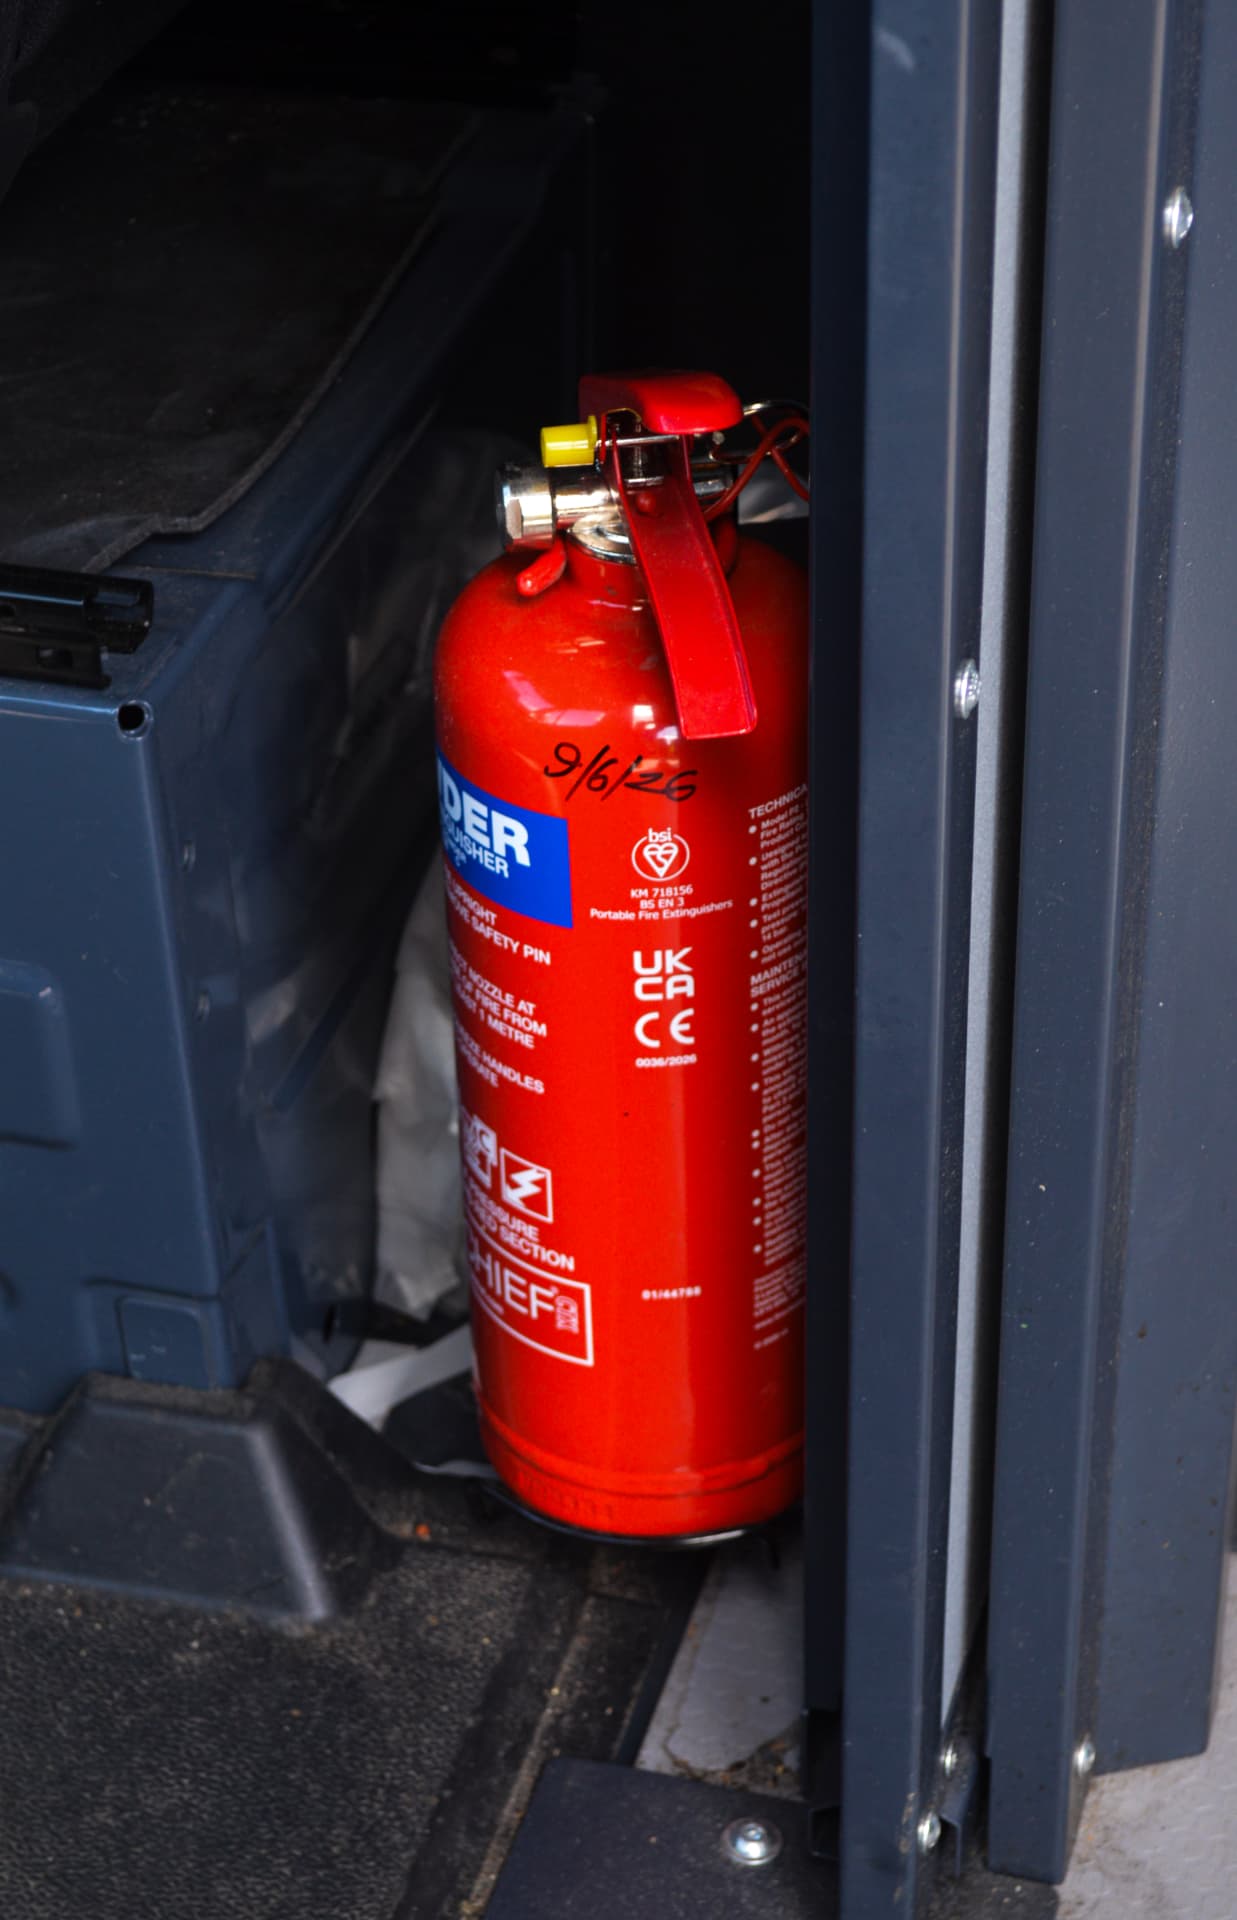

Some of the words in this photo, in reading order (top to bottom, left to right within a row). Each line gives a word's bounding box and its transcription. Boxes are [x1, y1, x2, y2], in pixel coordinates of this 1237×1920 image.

[437, 757, 531, 867] DER
[648, 828, 671, 842] bsi
[630, 888, 648, 898] KM
[652, 884, 693, 898] 718156
[640, 900, 655, 909] BS
[658, 898, 674, 908] EN
[590, 908, 635, 920] Portable
[638, 911, 659, 920] Fire
[662, 899, 733, 919] Extinguishers
[471, 915, 520, 954] SAFETY
[523, 944, 551, 966] PIN
[633, 947, 693, 975] UK
[503, 1007, 548, 1038] FROM
[517, 999, 537, 1017] AT
[487, 1014, 535, 1049] METRE
[634, 1008, 695, 1049] CE
[483, 1051, 545, 1094] HANDLES
[500, 1224, 575, 1271] SECTION
[466, 1235, 554, 1319] HIEF
